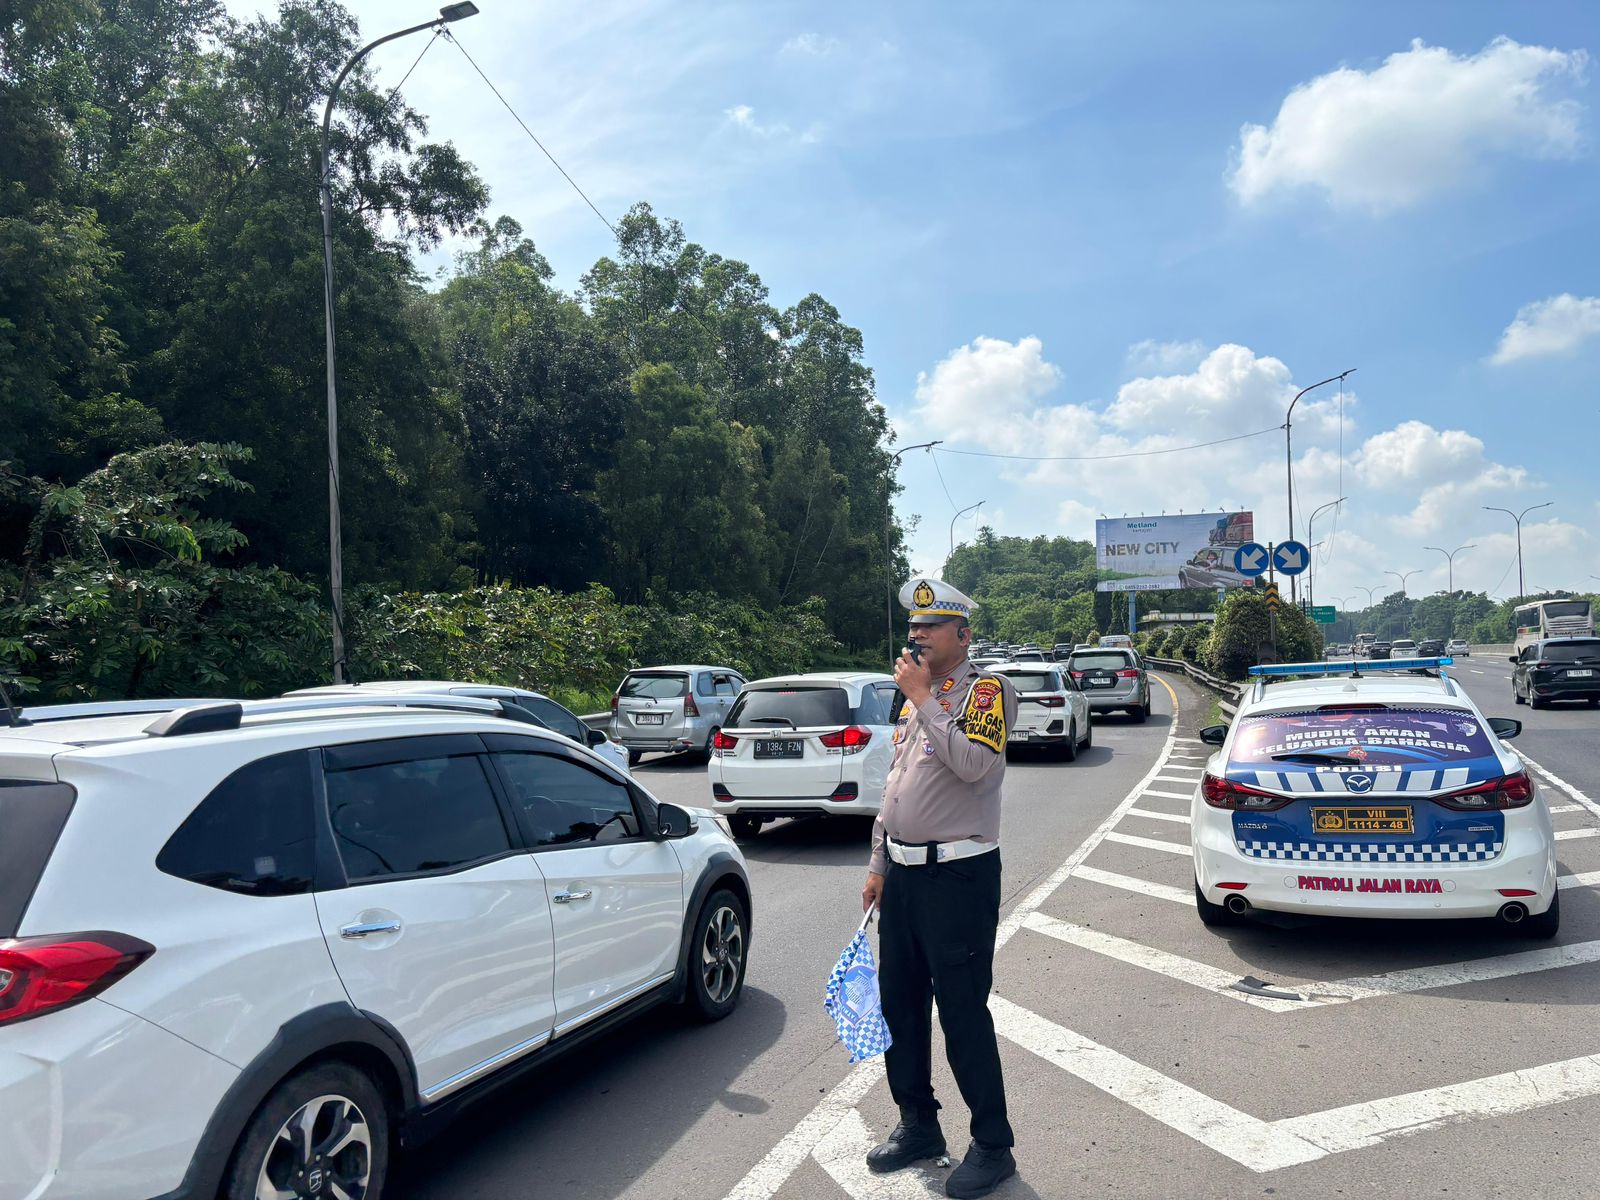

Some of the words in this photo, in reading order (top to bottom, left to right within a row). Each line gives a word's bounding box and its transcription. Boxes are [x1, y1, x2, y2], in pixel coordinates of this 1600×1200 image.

[1105, 543, 1140, 556] NEW
[1285, 729, 1356, 741] MUDIK
[1363, 728, 1431, 739] AMAN
[756, 742, 761, 752] B
[767, 742, 783, 752] 1384
[787, 741, 802, 752] FZN
[1315, 765, 1403, 773] POLISI
[1367, 810, 1386, 818] VIII
[1353, 821, 1380, 829] 1114
[1389, 821, 1404, 829] 48
[1298, 876, 1353, 892] PATROLI
[1356, 878, 1402, 893] JALAN
[1404, 879, 1443, 893] RAYA
